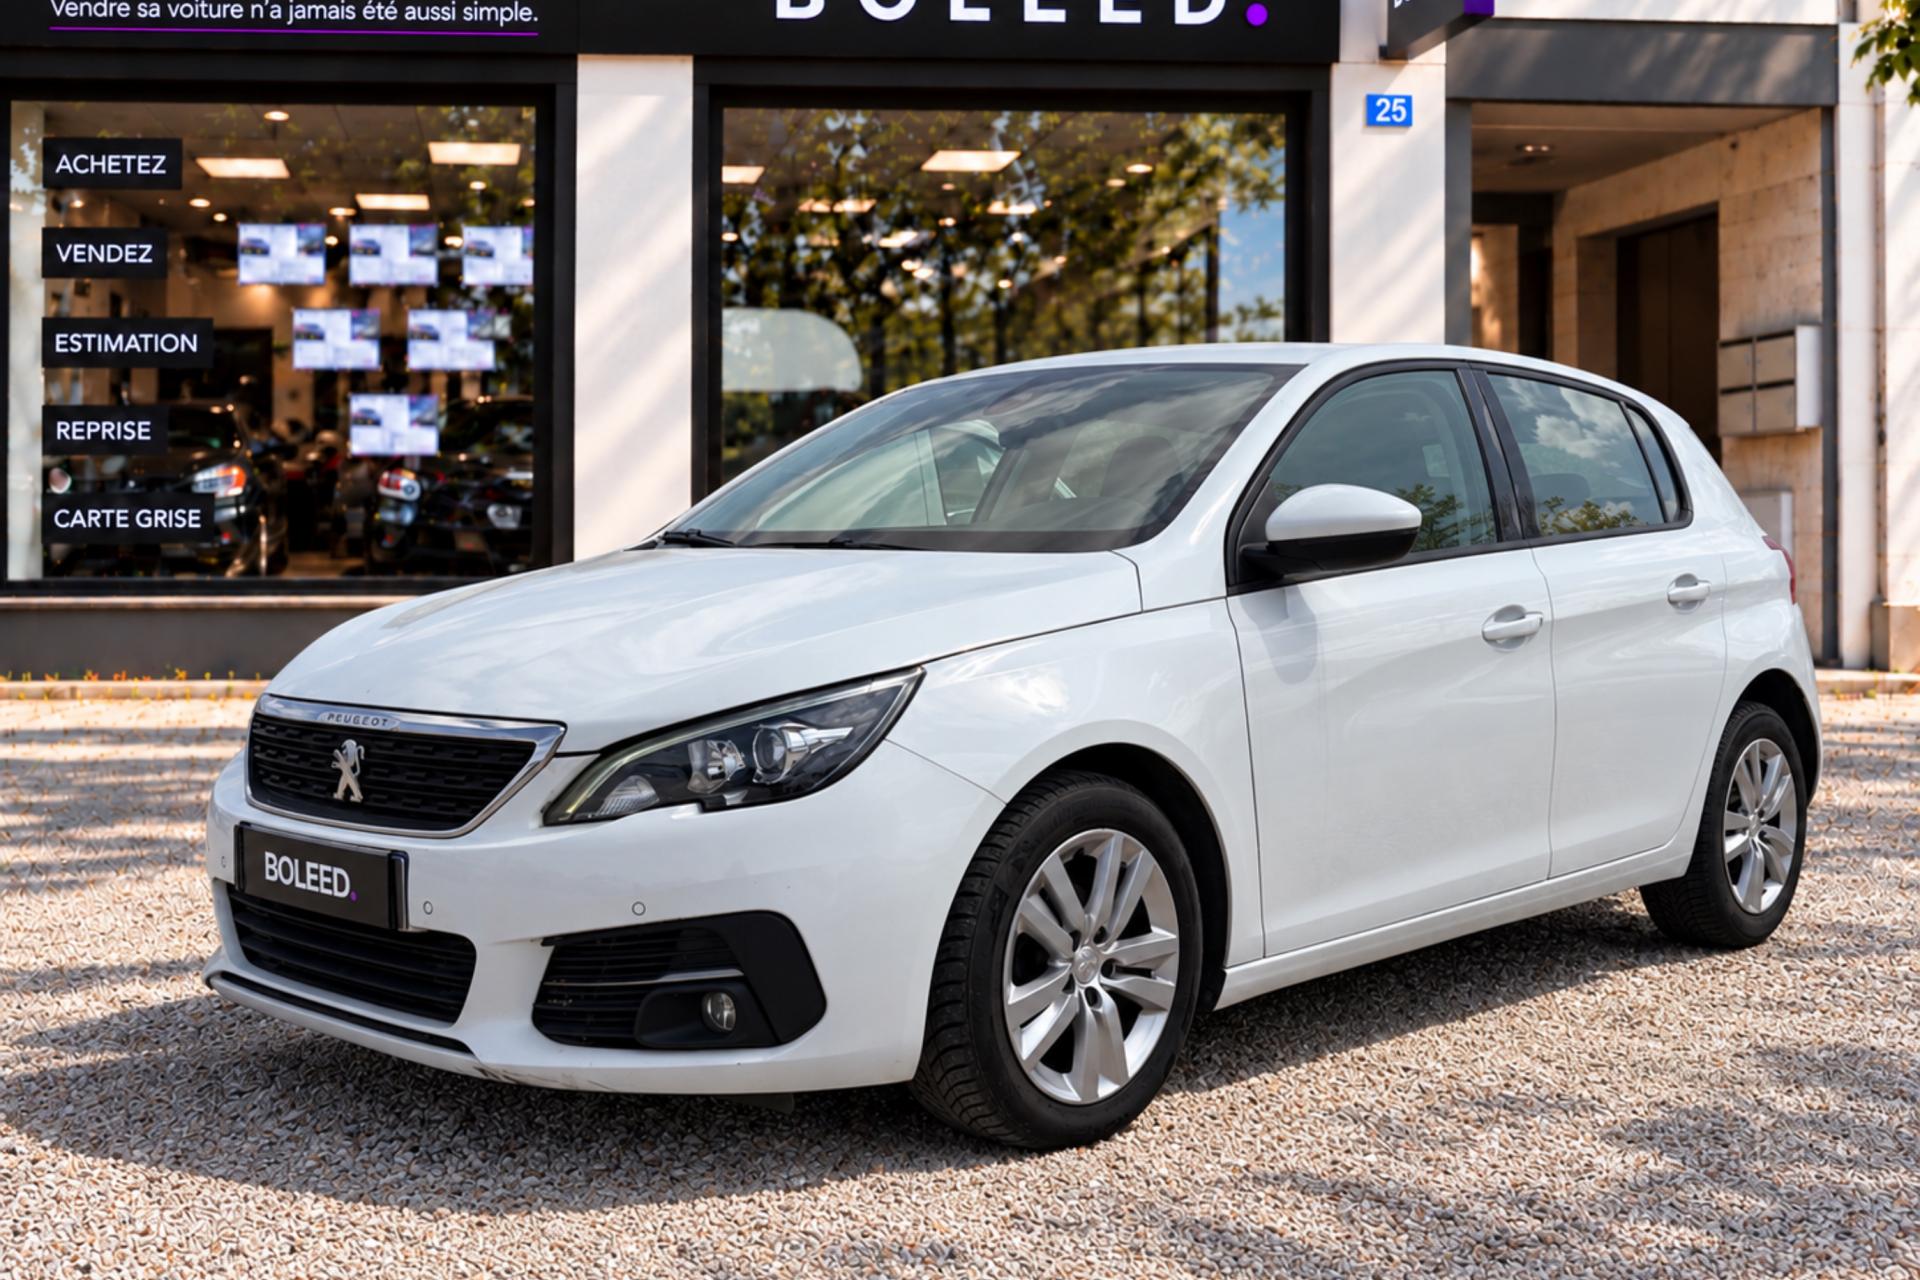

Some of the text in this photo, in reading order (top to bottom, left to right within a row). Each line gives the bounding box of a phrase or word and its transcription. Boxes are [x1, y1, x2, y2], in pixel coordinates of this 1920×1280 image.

[50, 0, 131, 18] Vendre
[137, 2, 161, 18] sa
[167, 0, 244, 19] voiture
[286, 0, 356, 25] jamais
[362, 0, 398, 21] été
[404, 0, 456, 22] aussi
[463, 0, 538, 27] simple.
[1376, 97, 1407, 122] 25
[55, 153, 167, 175] ACHETEZ
[55, 243, 153, 264] VENDEZ
[55, 332, 198, 354] ESTIMATION
[56, 420, 151, 441] REPRISE
[54, 508, 201, 529] CARTE GRISE
[326, 712, 389, 727] PEUGEOT
